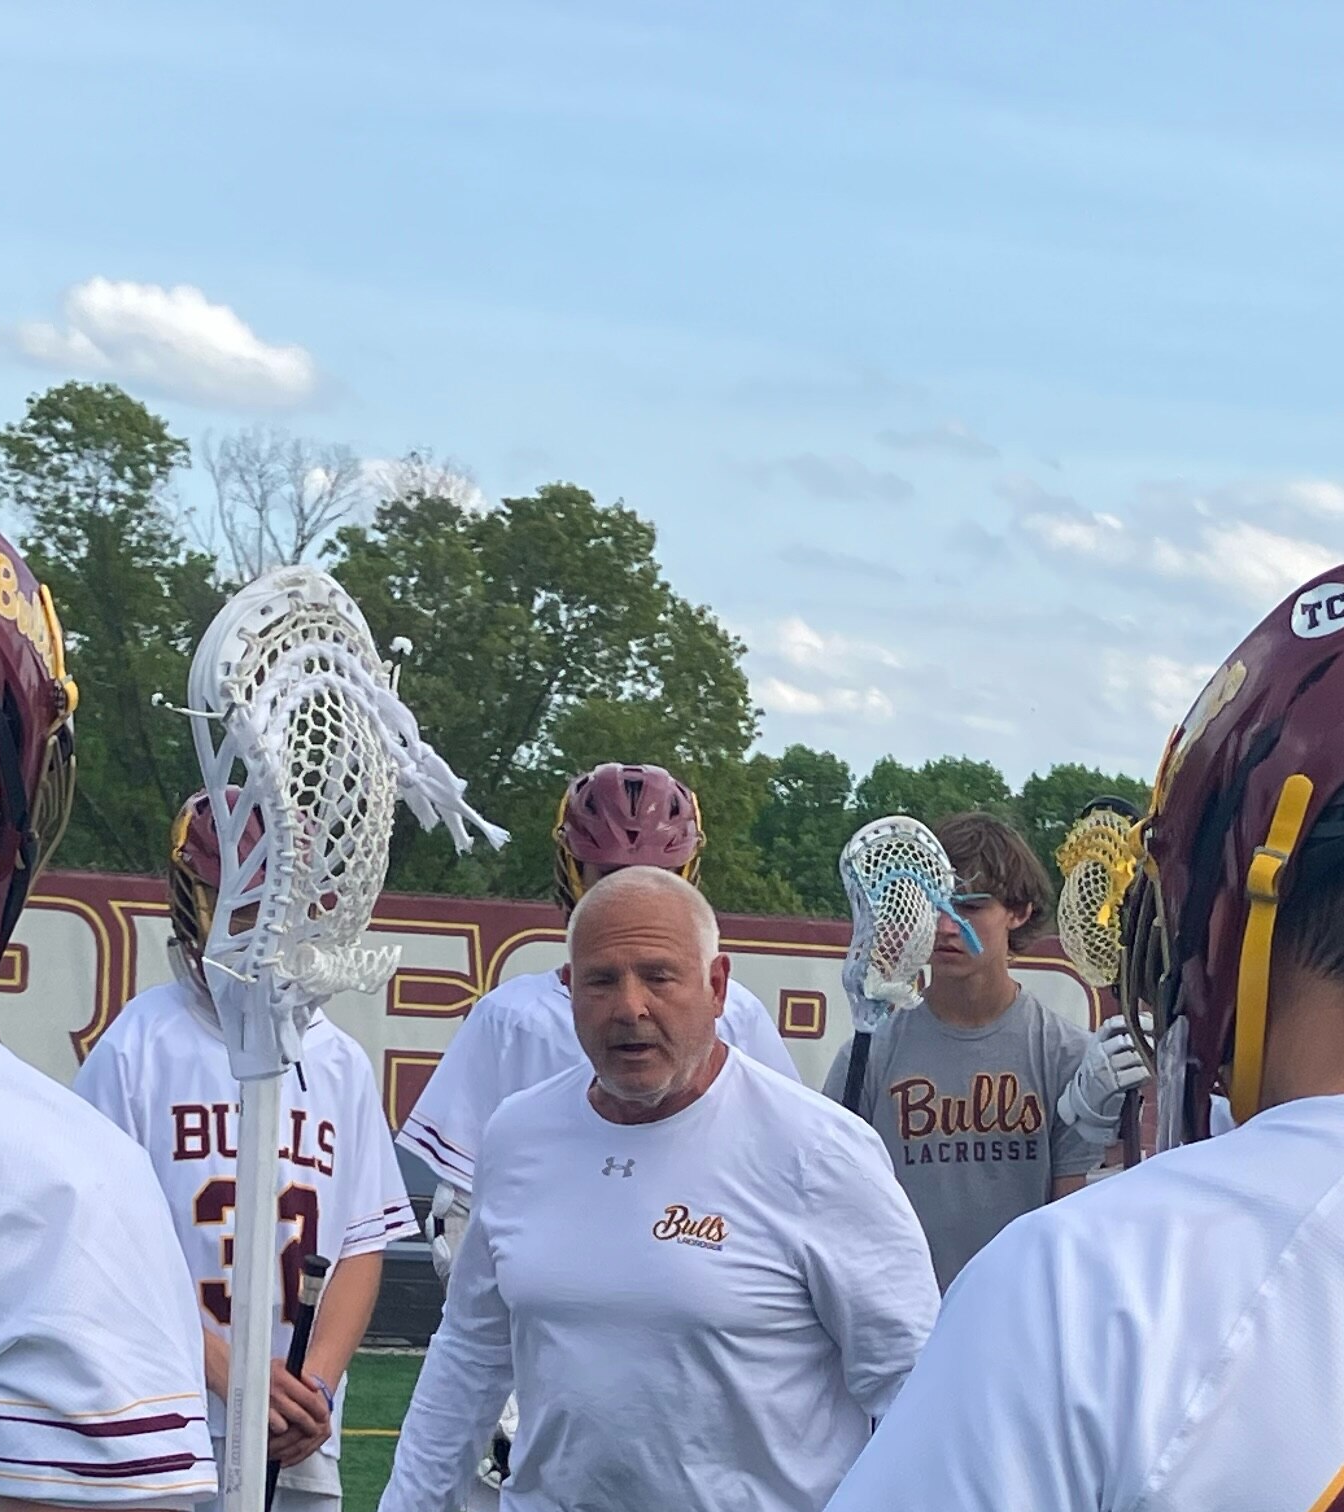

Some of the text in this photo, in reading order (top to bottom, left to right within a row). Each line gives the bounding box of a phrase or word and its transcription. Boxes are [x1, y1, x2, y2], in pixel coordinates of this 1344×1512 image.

[889, 1071, 1044, 1141] Bulls
[170, 1103, 337, 1178] BULS
[903, 1138, 1038, 1166] LACROSSE
[652, 1204, 730, 1243] Bulls
